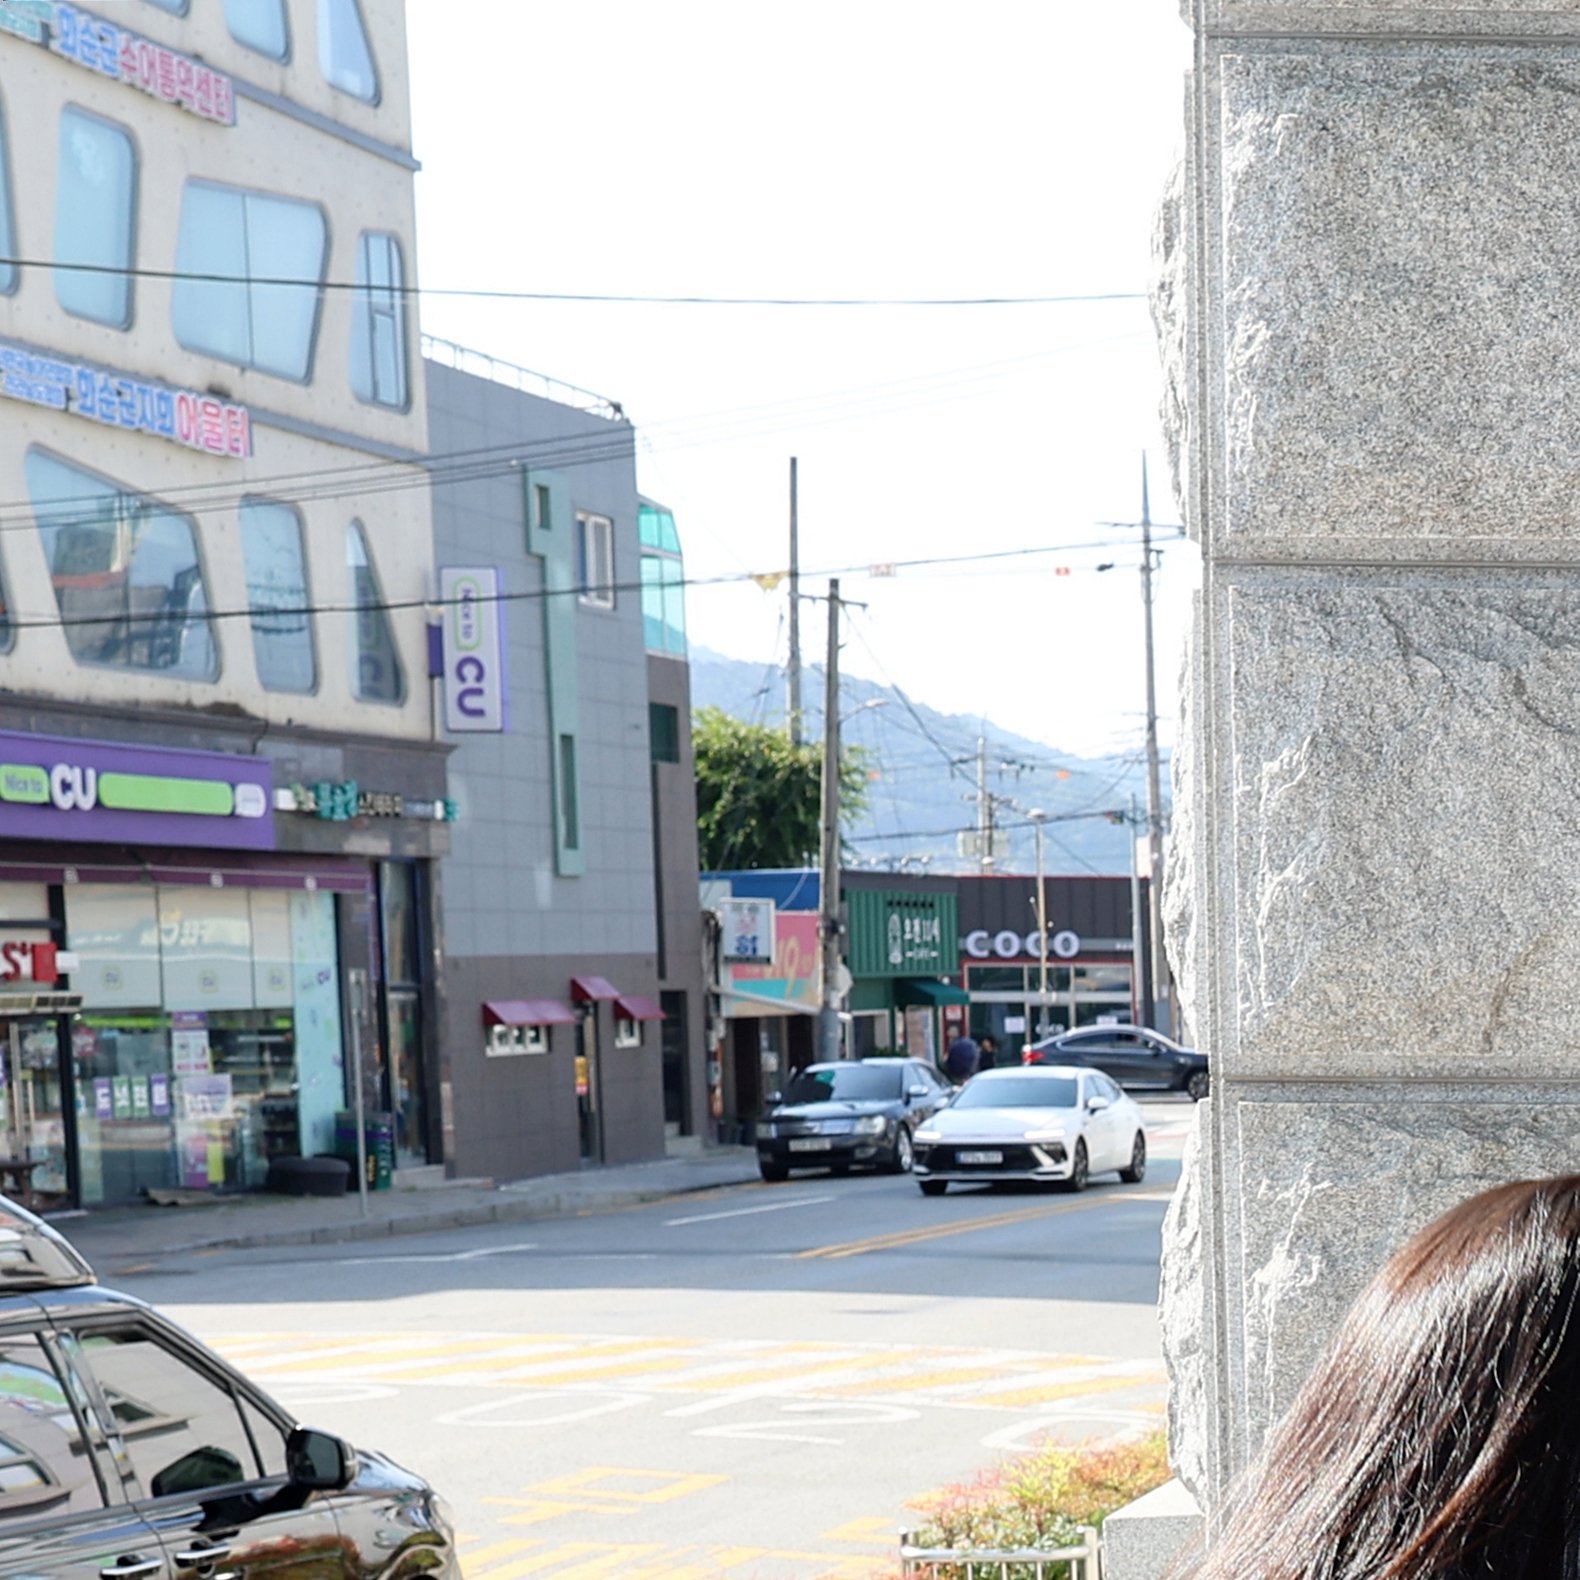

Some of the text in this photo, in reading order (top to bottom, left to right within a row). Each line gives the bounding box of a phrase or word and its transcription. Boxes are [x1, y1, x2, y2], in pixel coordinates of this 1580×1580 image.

[455, 656, 486, 717] CU
[51, 763, 97, 811] CU
[965, 930, 1080, 958] COCO
